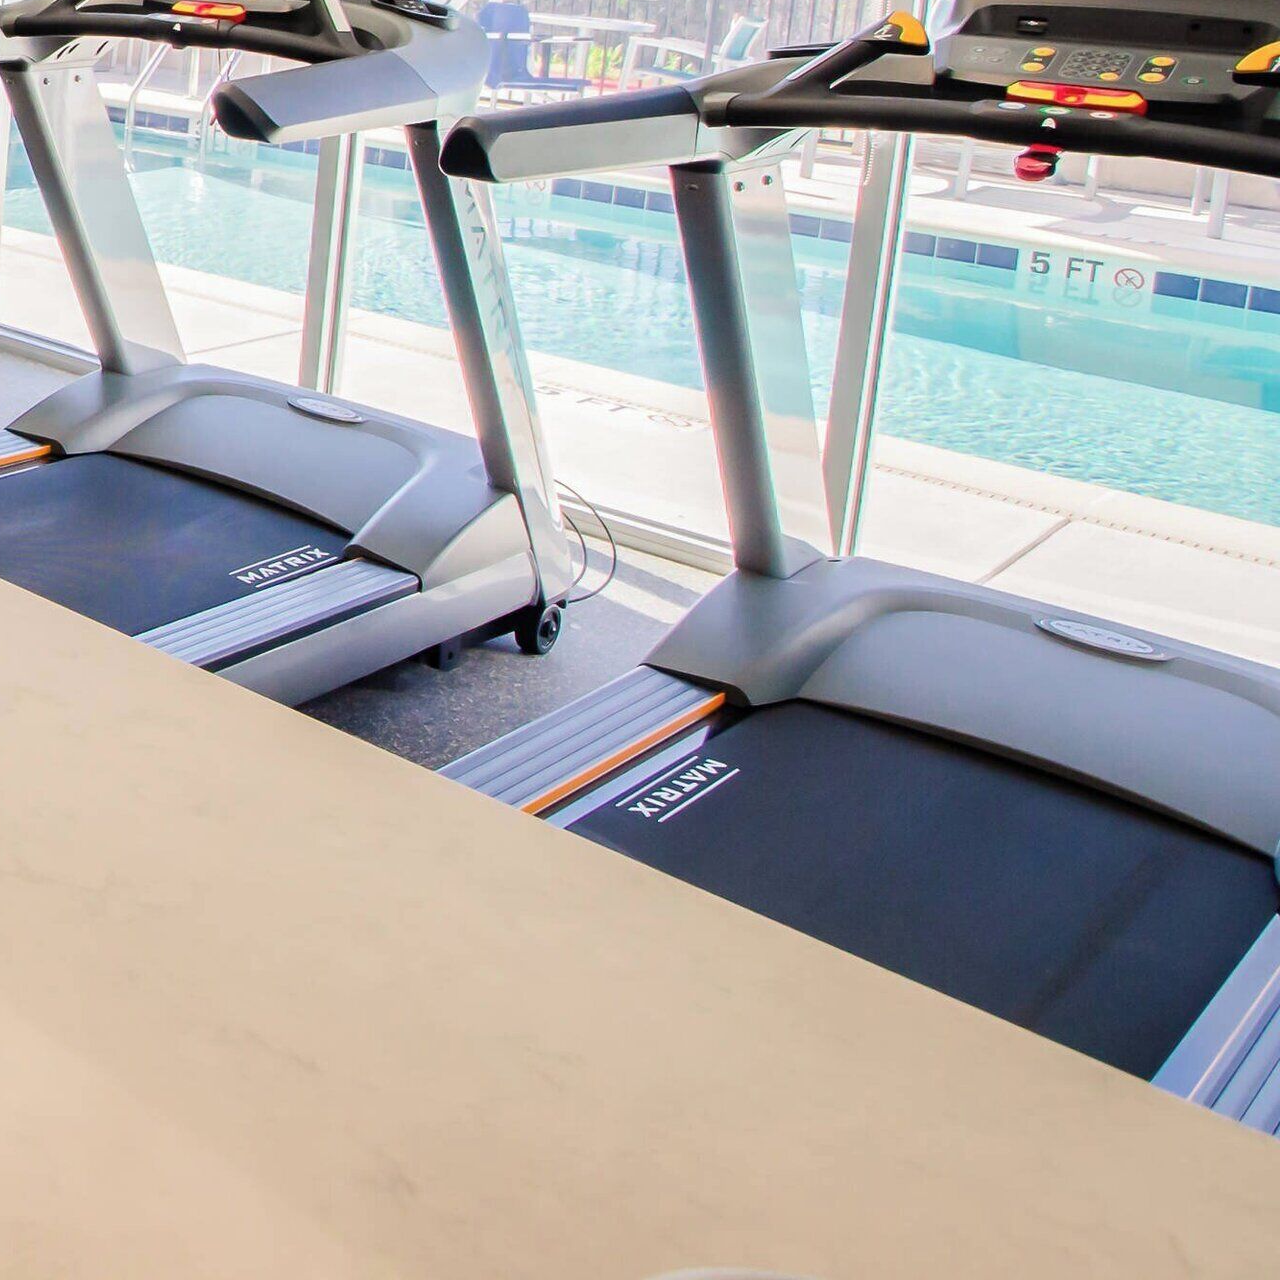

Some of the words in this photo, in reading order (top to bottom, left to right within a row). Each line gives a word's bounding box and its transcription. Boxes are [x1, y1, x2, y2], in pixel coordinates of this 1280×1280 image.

[1030, 251, 1051, 274] 5
[1066, 256, 1104, 282] FT
[236, 547, 330, 585] MATRIX
[627, 758, 728, 818] MATRIX
